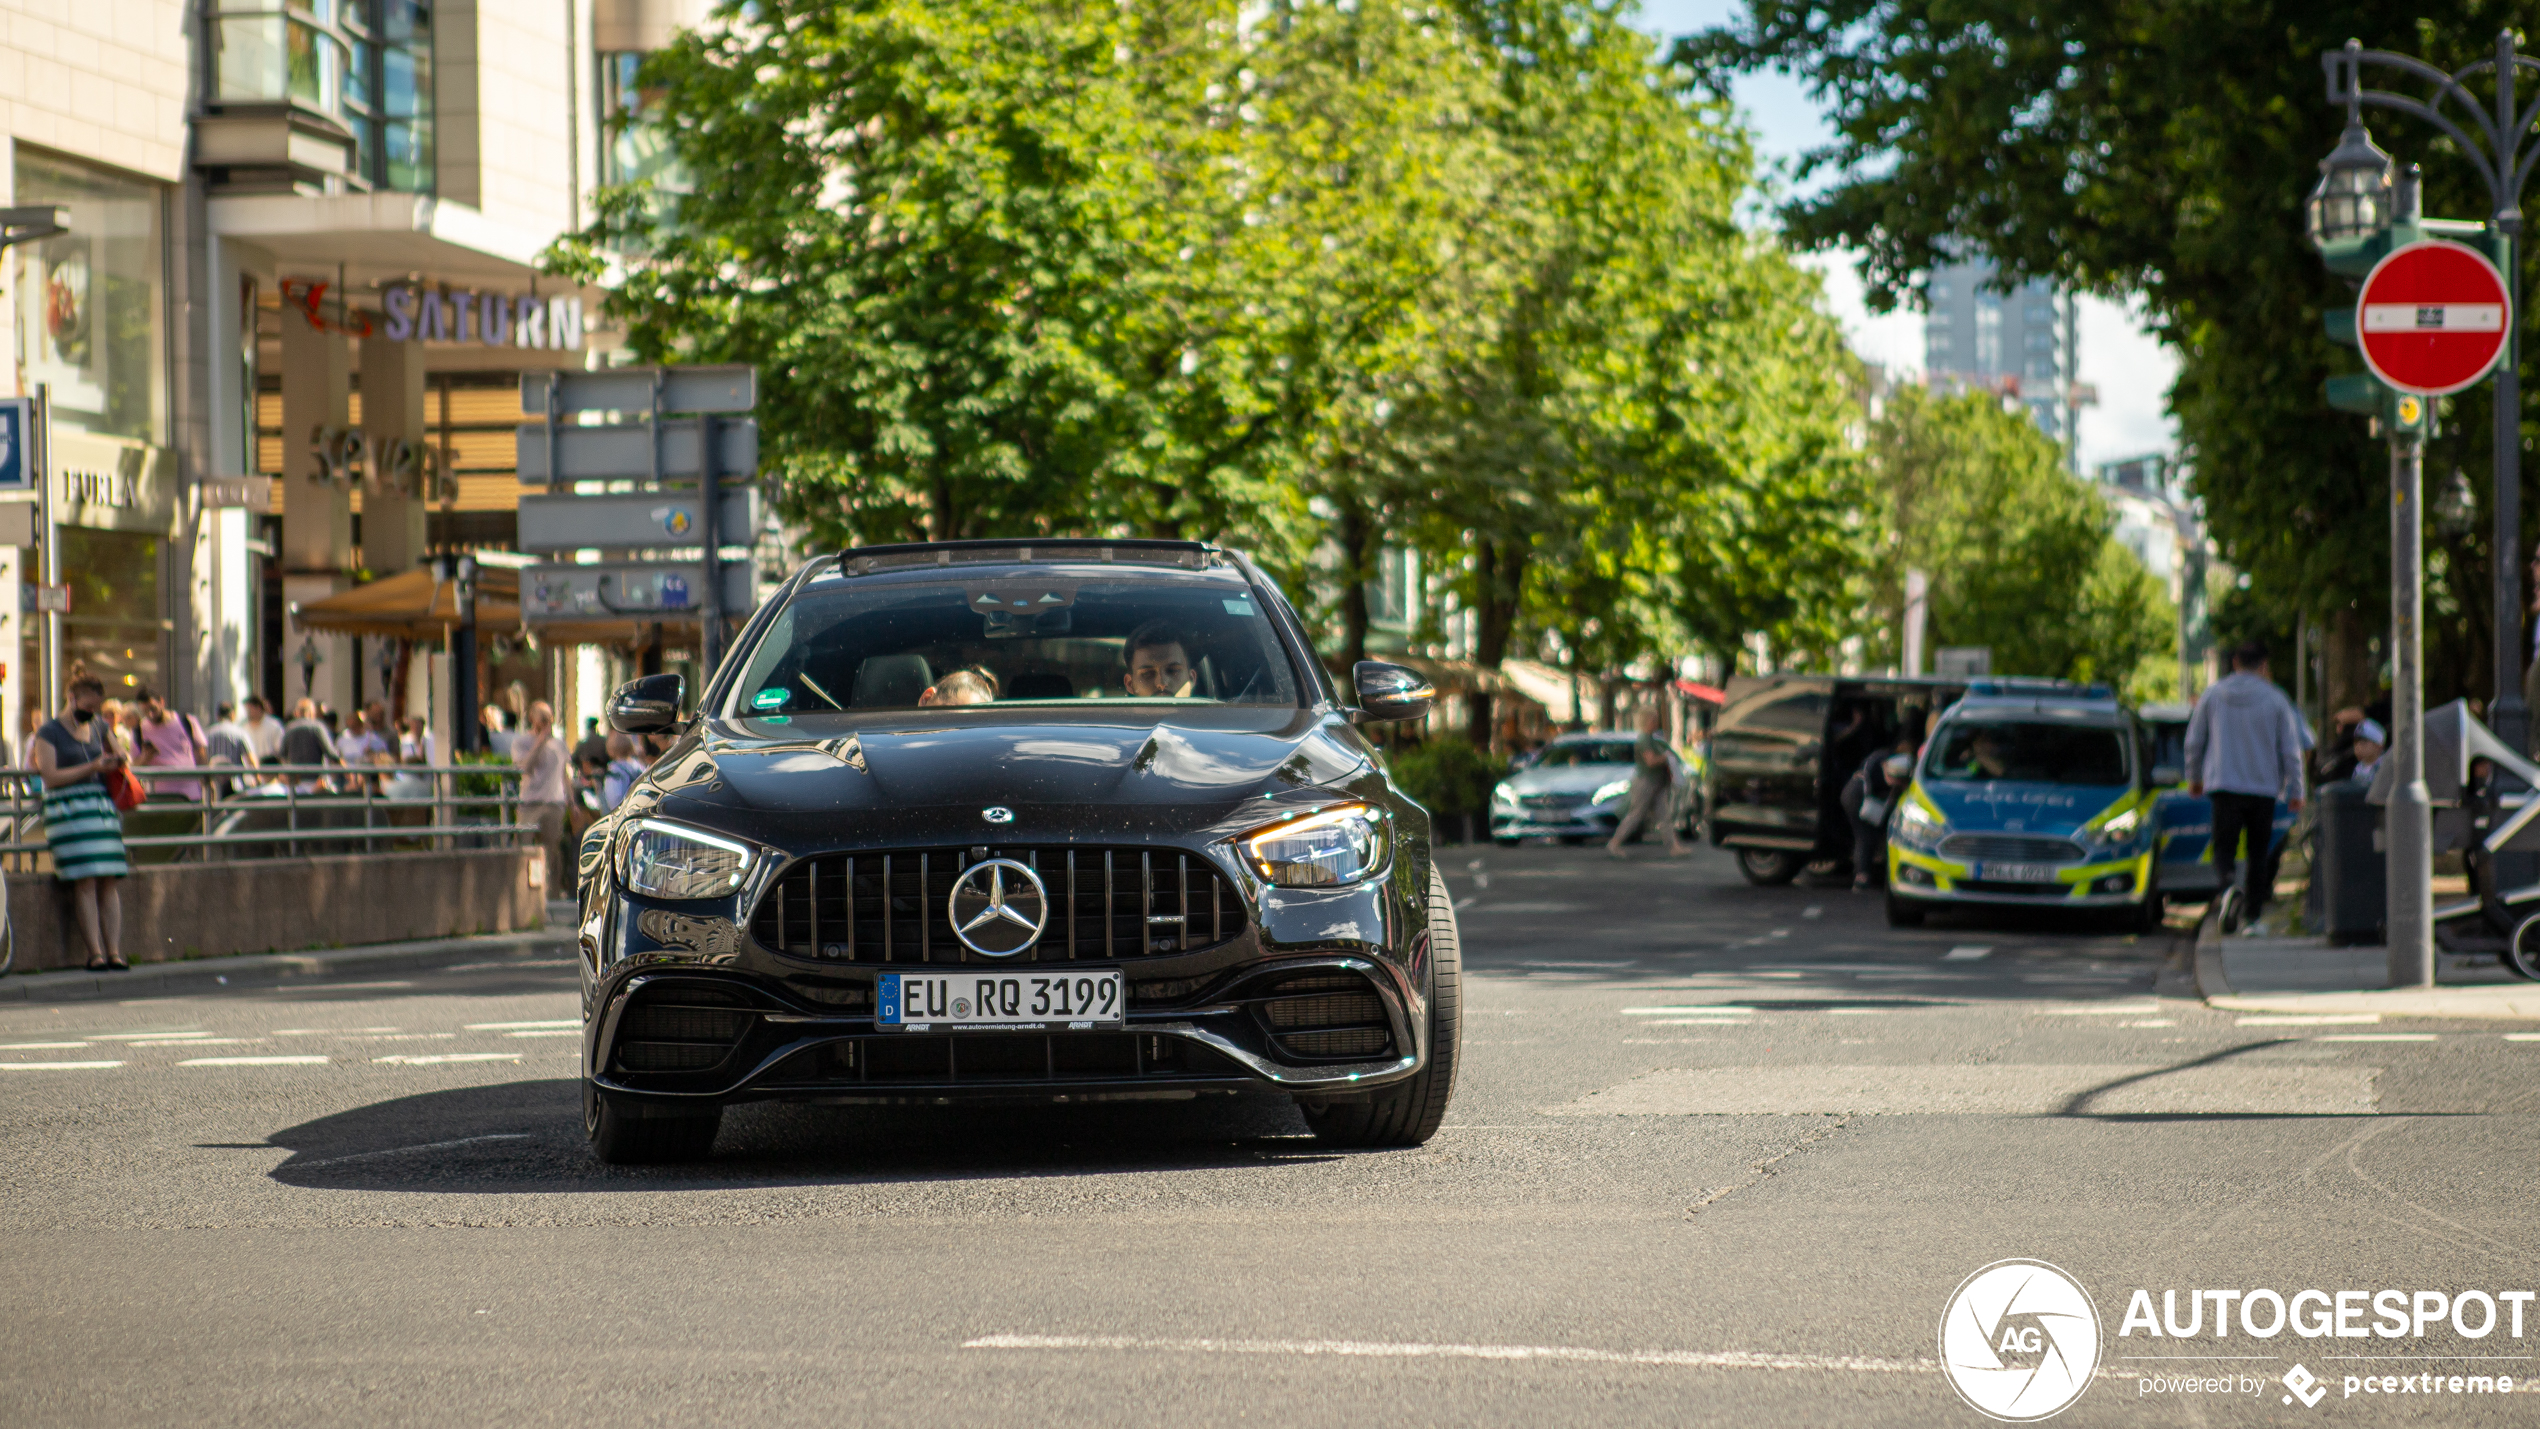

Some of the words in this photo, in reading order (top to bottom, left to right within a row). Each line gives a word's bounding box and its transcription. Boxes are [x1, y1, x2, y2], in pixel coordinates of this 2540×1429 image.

[384, 286, 582, 350] SATURN
[63, 470, 136, 508] FURLA
[903, 979, 947, 1018] EU
[976, 979, 1020, 1017] RQ
[1030, 978, 1117, 1016] 3199
[885, 1005, 894, 1016] D
[905, 1023, 930, 1032] ARNDT
[952, 1022, 1046, 1031] www.autovermietung-arndt.de
[1067, 1021, 1093, 1030] ARNDT
